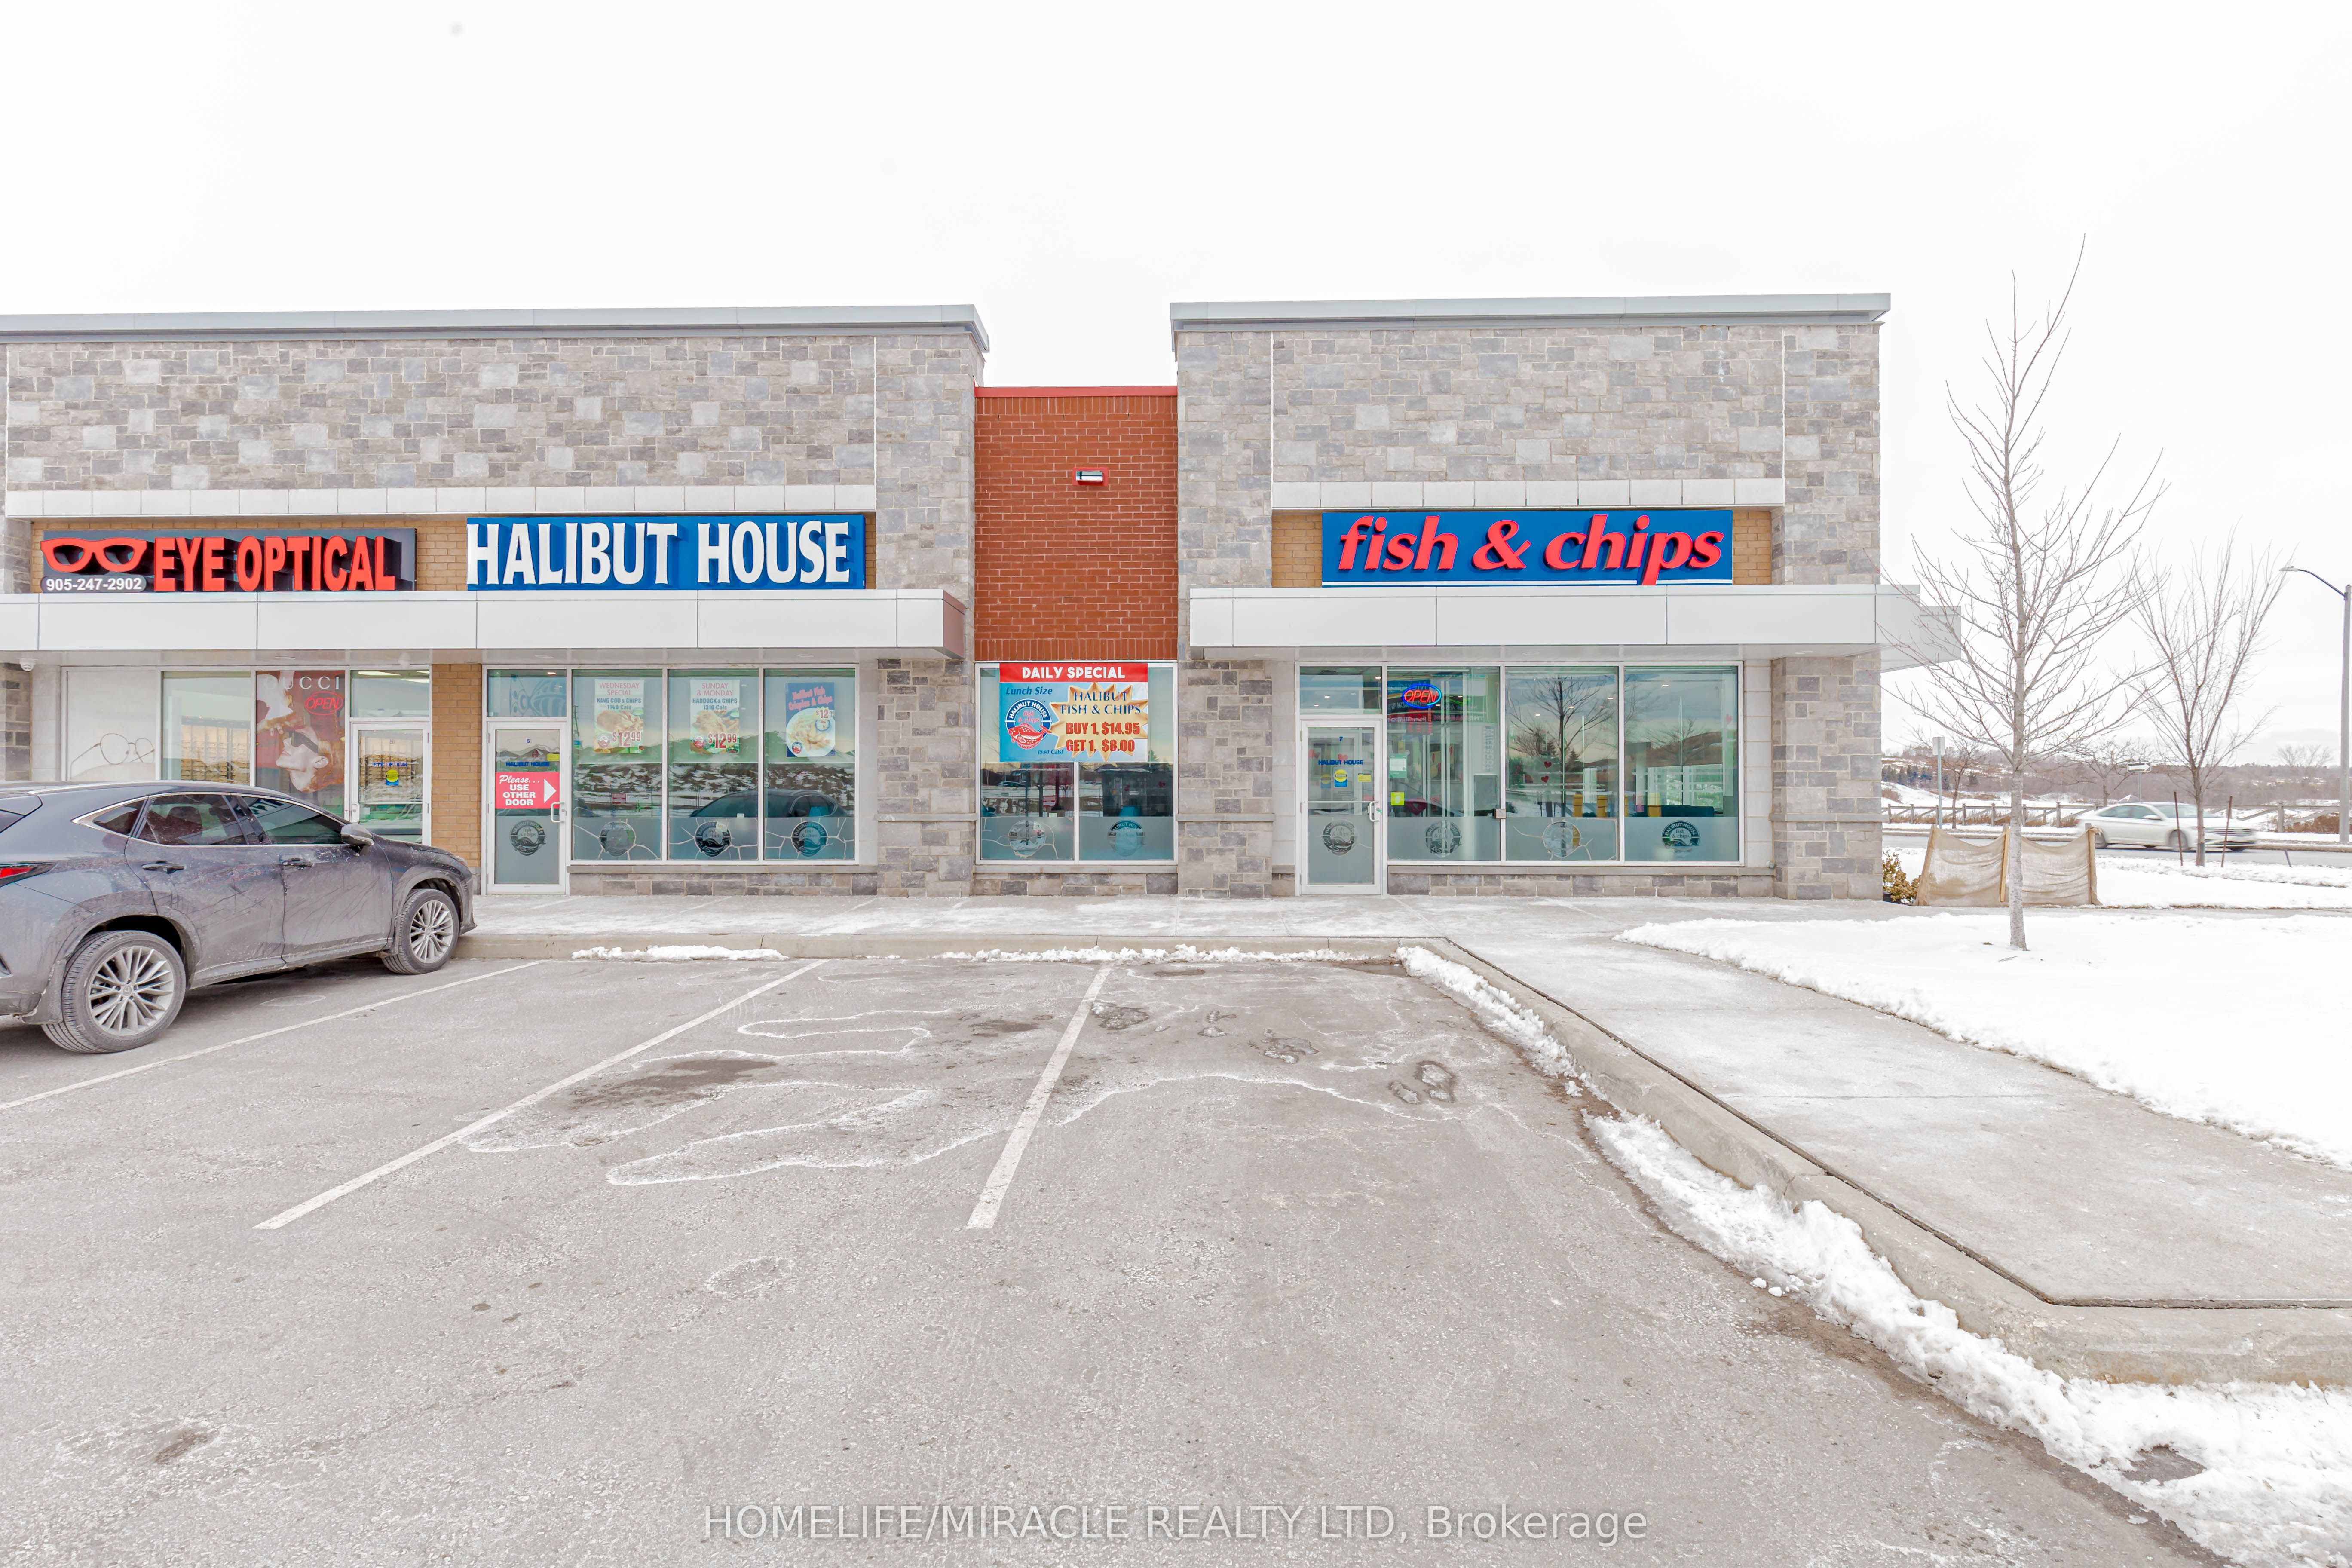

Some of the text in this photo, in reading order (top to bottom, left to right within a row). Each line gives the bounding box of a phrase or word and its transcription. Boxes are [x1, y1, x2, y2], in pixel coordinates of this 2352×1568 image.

[466, 520, 850, 585] HALIBUT HOUSE
[1338, 514, 1724, 586] fish & chips
[154, 535, 395, 592] EYE OPTICAL
[46, 578, 142, 591] 905-247-2902
[1022, 666, 1125, 679] DAILY SPECIAL
[1006, 686, 1032, 695] Lunch
[1074, 692, 1128, 701] HALIBUT
[1404, 689, 1438, 703] OPEN
[306, 698, 340, 709] OPEN
[1008, 701, 1048, 719] HALIBUT HOUSE
[1061, 704, 1141, 714] FISH & CHIPS
[1066, 721, 1140, 735] BUY 1, $14.95
[1066, 738, 1135, 753] GET 1, $8.00
[499, 775, 540, 784] Please...
